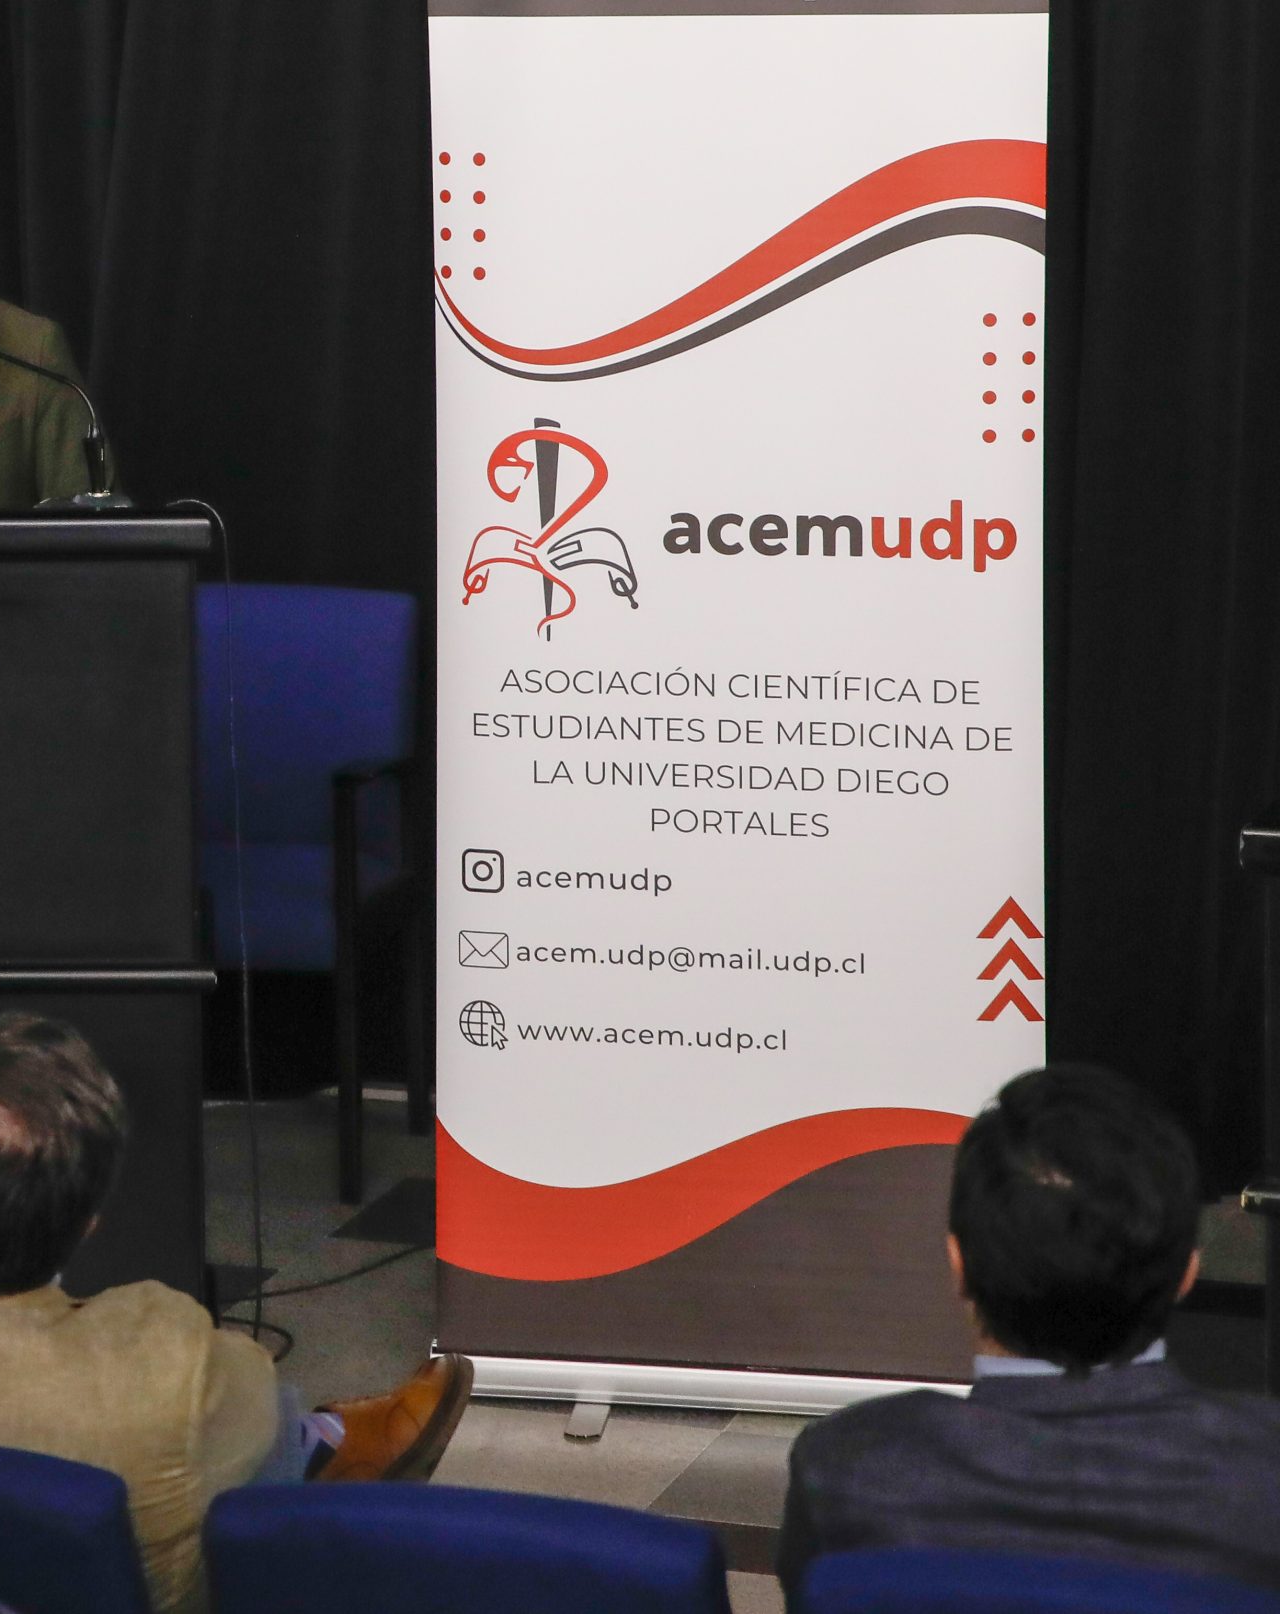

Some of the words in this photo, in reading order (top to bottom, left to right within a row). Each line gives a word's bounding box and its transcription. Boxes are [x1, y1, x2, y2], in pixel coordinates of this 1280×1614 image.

[662, 499, 1018, 573] acemudp
[500, 666, 716, 698] ASOCIACIÓN
[728, 670, 922, 704] CIENTÍFICA
[933, 679, 981, 706] DE
[473, 712, 706, 743] ESTUDIANTES
[718, 719, 764, 745] DE
[777, 720, 954, 751] MEDICINA
[966, 726, 1014, 752] DE
[533, 759, 574, 785] LA
[585, 760, 825, 792] UNIVERSIDAD
[837, 768, 950, 797] DIEGO
[651, 807, 830, 838] PORTALES
[517, 867, 673, 898] acemudp
[517, 943, 866, 978] acem.udp@mail.udp.cl
[517, 1024, 788, 1054] www.acem.udp.cl
